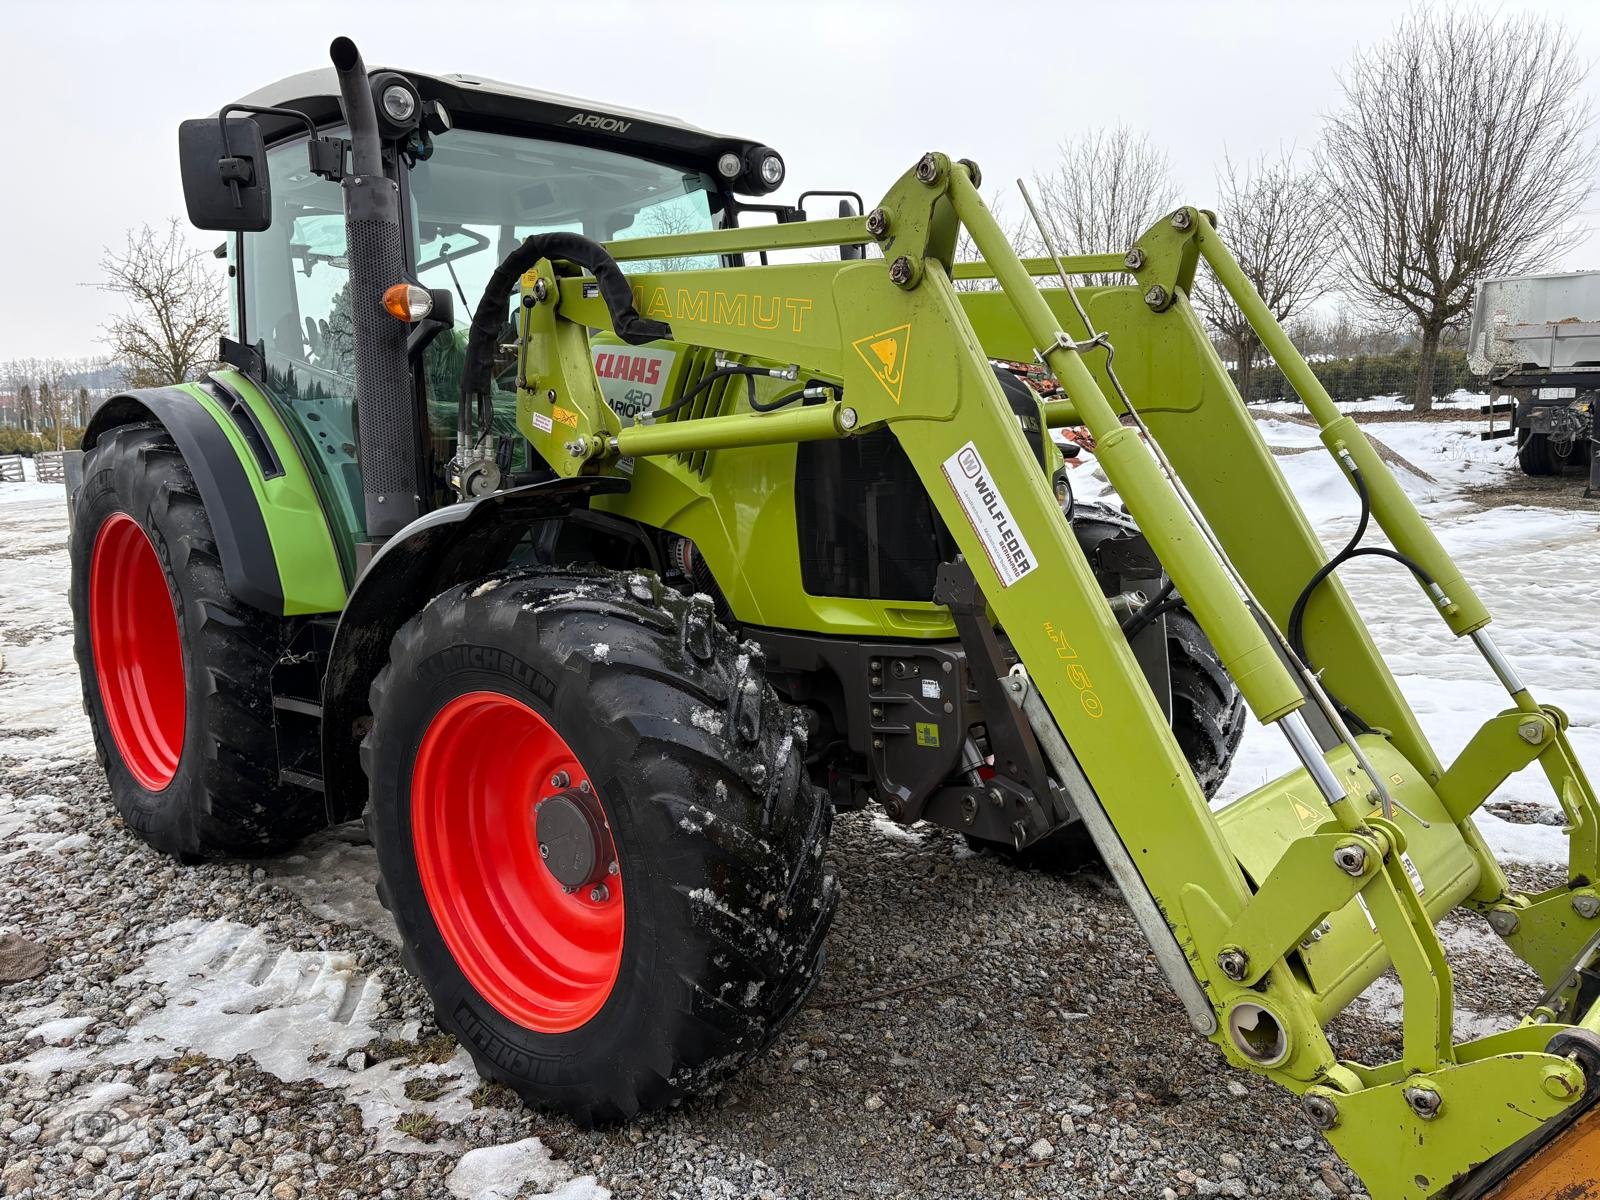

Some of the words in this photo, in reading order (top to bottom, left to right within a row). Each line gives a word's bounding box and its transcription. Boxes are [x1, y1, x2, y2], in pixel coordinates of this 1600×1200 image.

[566, 113, 632, 133] ARION
[594, 353, 662, 385] CLAAS
[624, 388, 653, 408] 420
[962, 453, 978, 472] W
[974, 475, 1031, 575] WÖLFLEDER
[441, 644, 556, 697] MICHELIN
[1056, 629, 1103, 718] 150
[454, 1005, 561, 1083] MICHELIN
